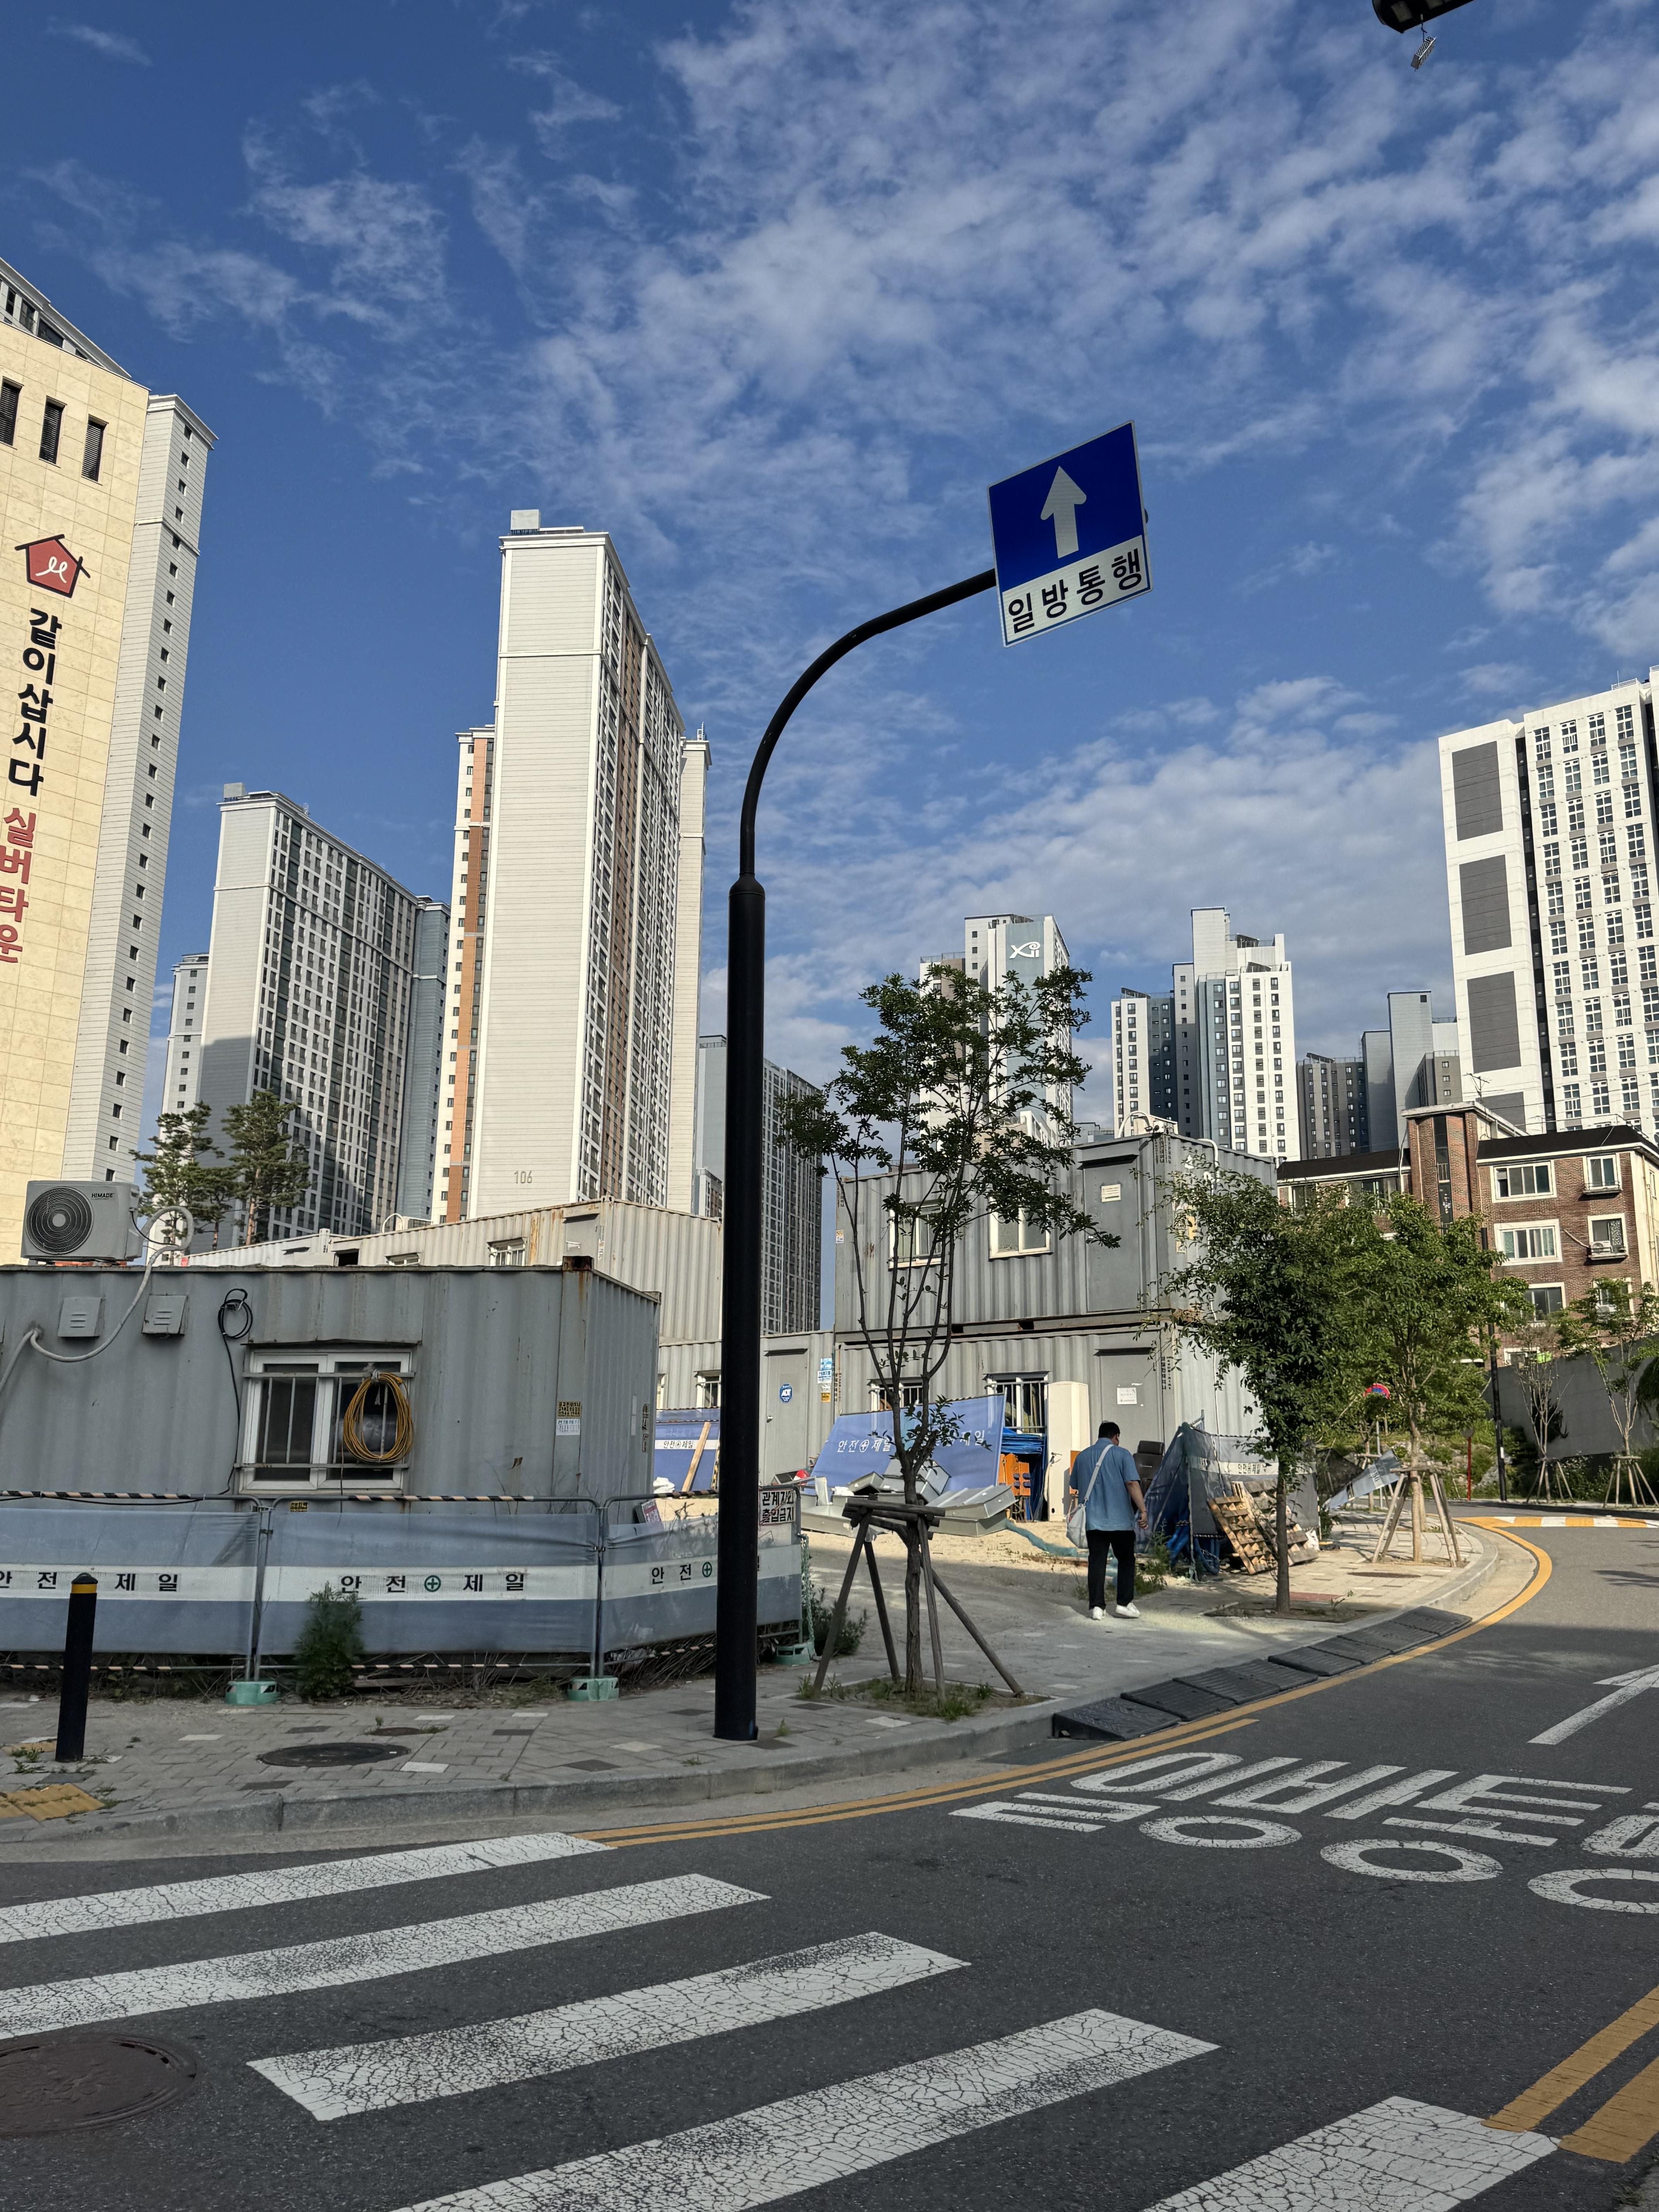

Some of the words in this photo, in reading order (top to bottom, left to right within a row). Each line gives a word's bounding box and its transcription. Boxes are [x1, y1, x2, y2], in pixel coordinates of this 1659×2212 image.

[1008, 548, 1142, 634] 일방통행
[0, 808, 36, 963] 실버타운
[514, 1170, 532, 1183] 106
[837, 1440, 859, 1452] 안전
[762, 1491, 794, 1506] 관계자외
[762, 1507, 794, 1523] 출입금지
[0, 1571, 57, 1589] 안전
[116, 1573, 178, 1592] 제일
[340, 1575, 405, 1593] 안전
[463, 1574, 524, 1592] 제일
[651, 1564, 691, 1584] 안전
